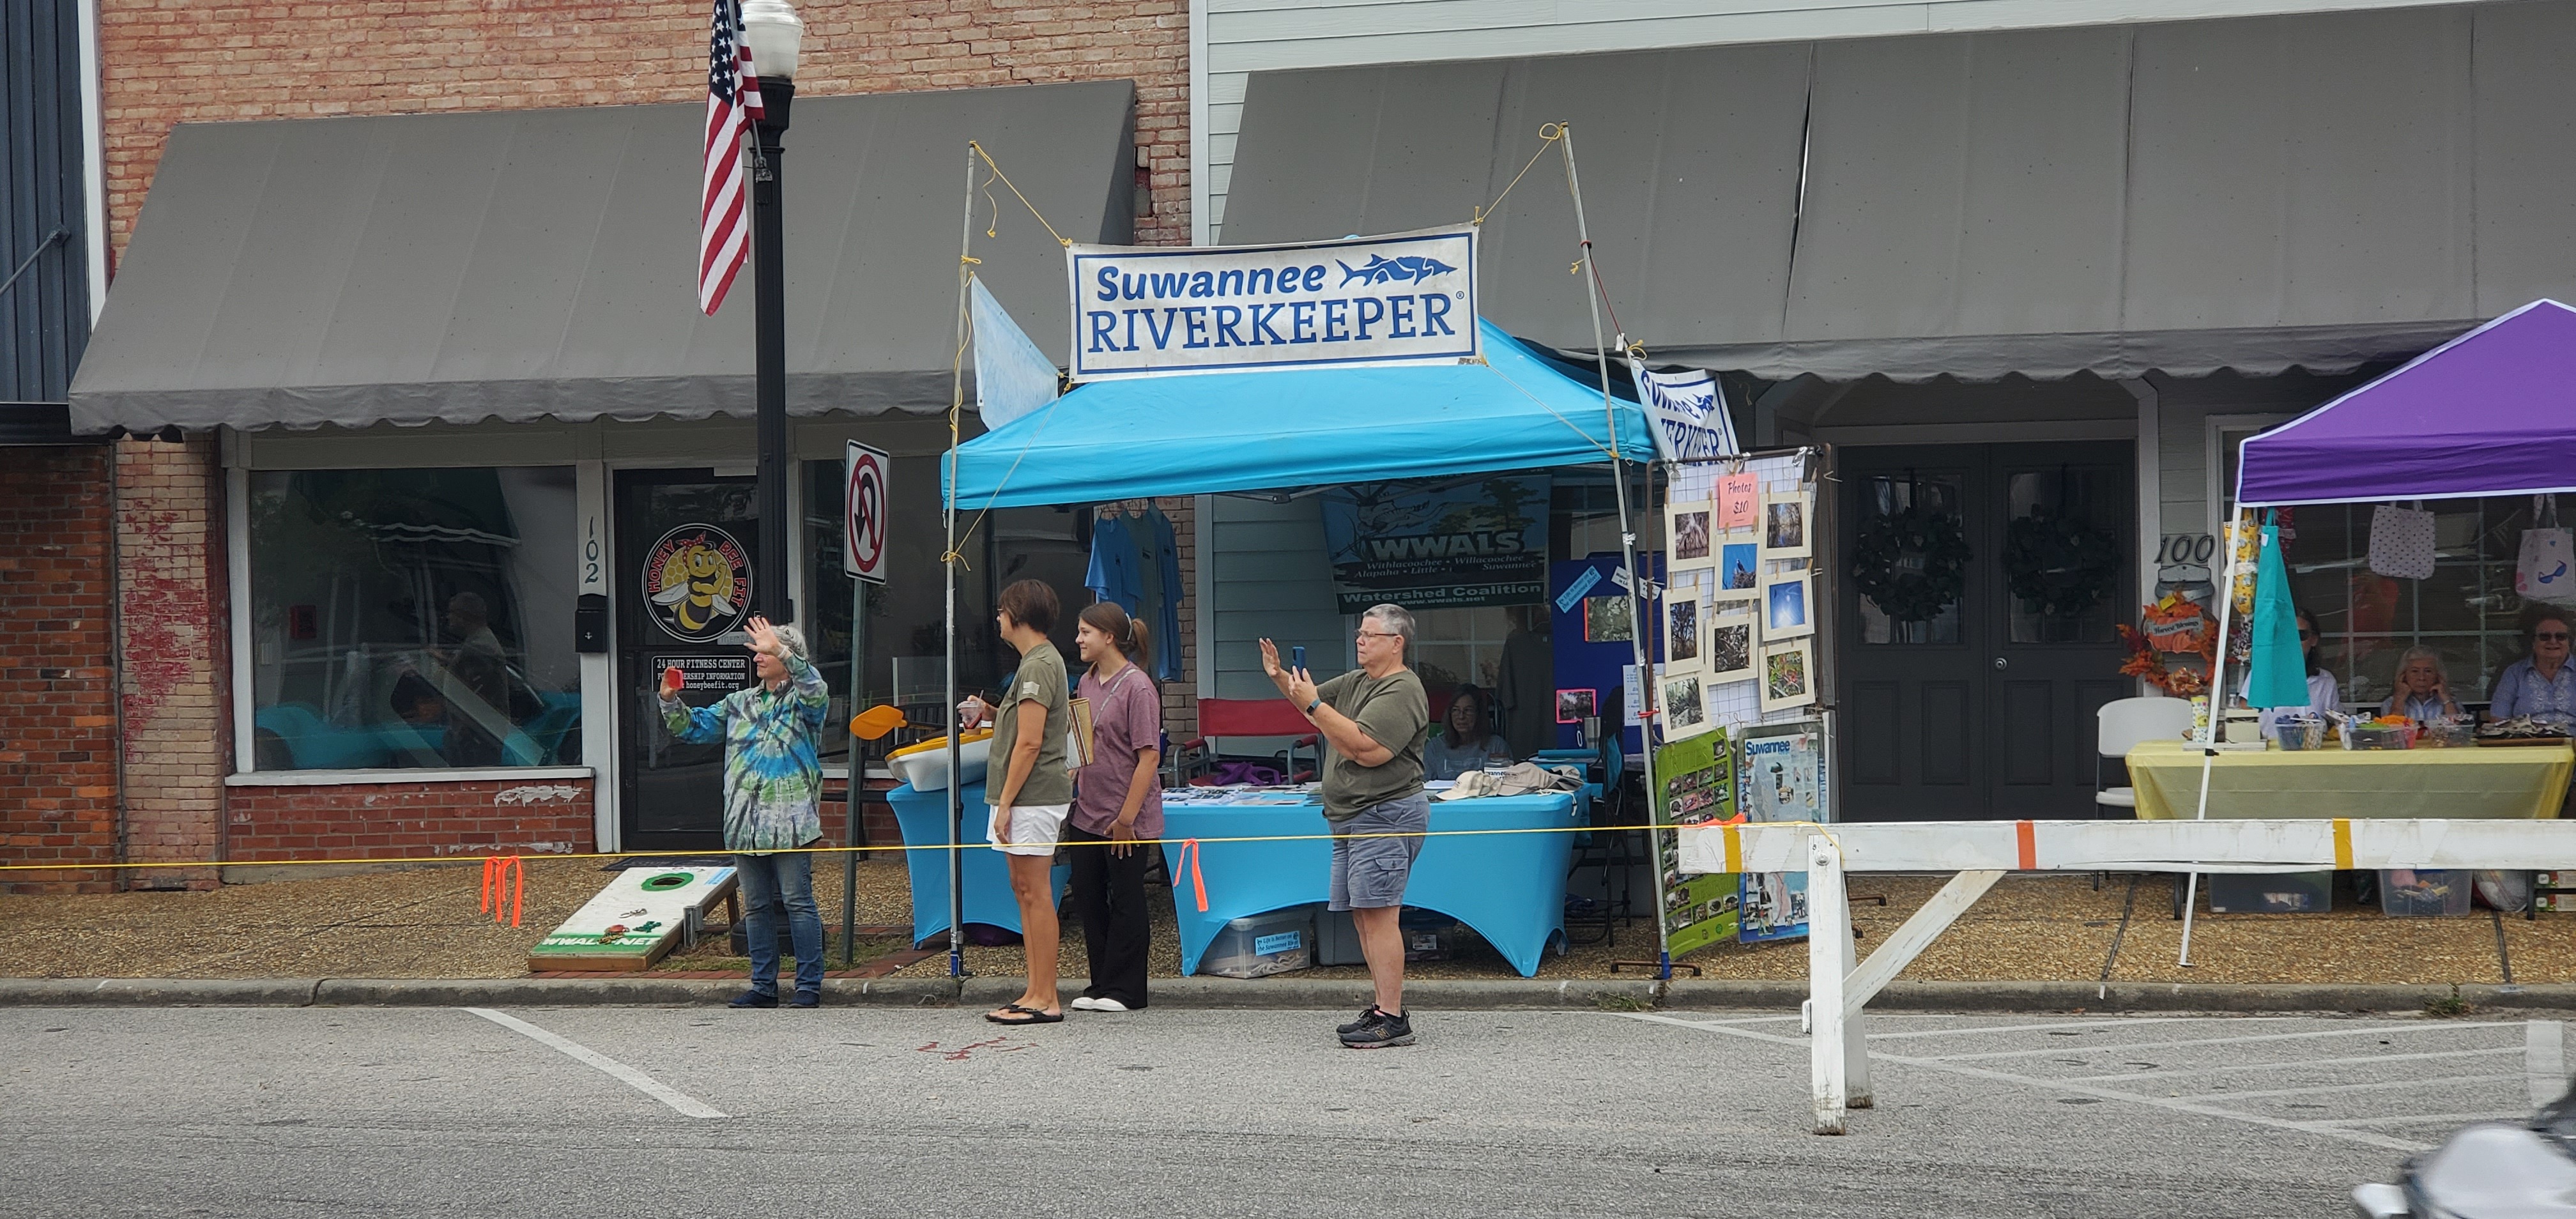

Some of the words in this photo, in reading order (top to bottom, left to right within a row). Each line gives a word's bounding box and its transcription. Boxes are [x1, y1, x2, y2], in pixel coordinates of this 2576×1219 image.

[1097, 264, 1326, 301] Suwannee
[1728, 480, 1752, 495] Photos
[1733, 500, 1749, 515] $10
[585, 516, 599, 584] 102
[1370, 531, 1521, 560] WWALS
[2154, 534, 2216, 564] 100
[1354, 568, 1399, 578] Alapaha
[1411, 566, 1438, 574] Little
[1482, 561, 1537, 571] Suwannee
[1367, 559, 1442, 570] Withlacoochee
[1455, 555, 1524, 565] Willacoochee
[648, 539, 675, 593] HONEY
[718, 540, 744, 571] BEE
[731, 577, 747, 608] FIT
[1344, 588, 1445, 603] Watershed
[1452, 584, 1541, 596] Coalition
[657, 659, 666, 668] 24
[667, 659, 686, 669] HOUR
[686, 659, 716, 668] FITNESS
[718, 659, 746, 668] CENTER
[686, 681, 739, 690] honeybeefit.org
[1746, 740, 1791, 756] Suwannee
